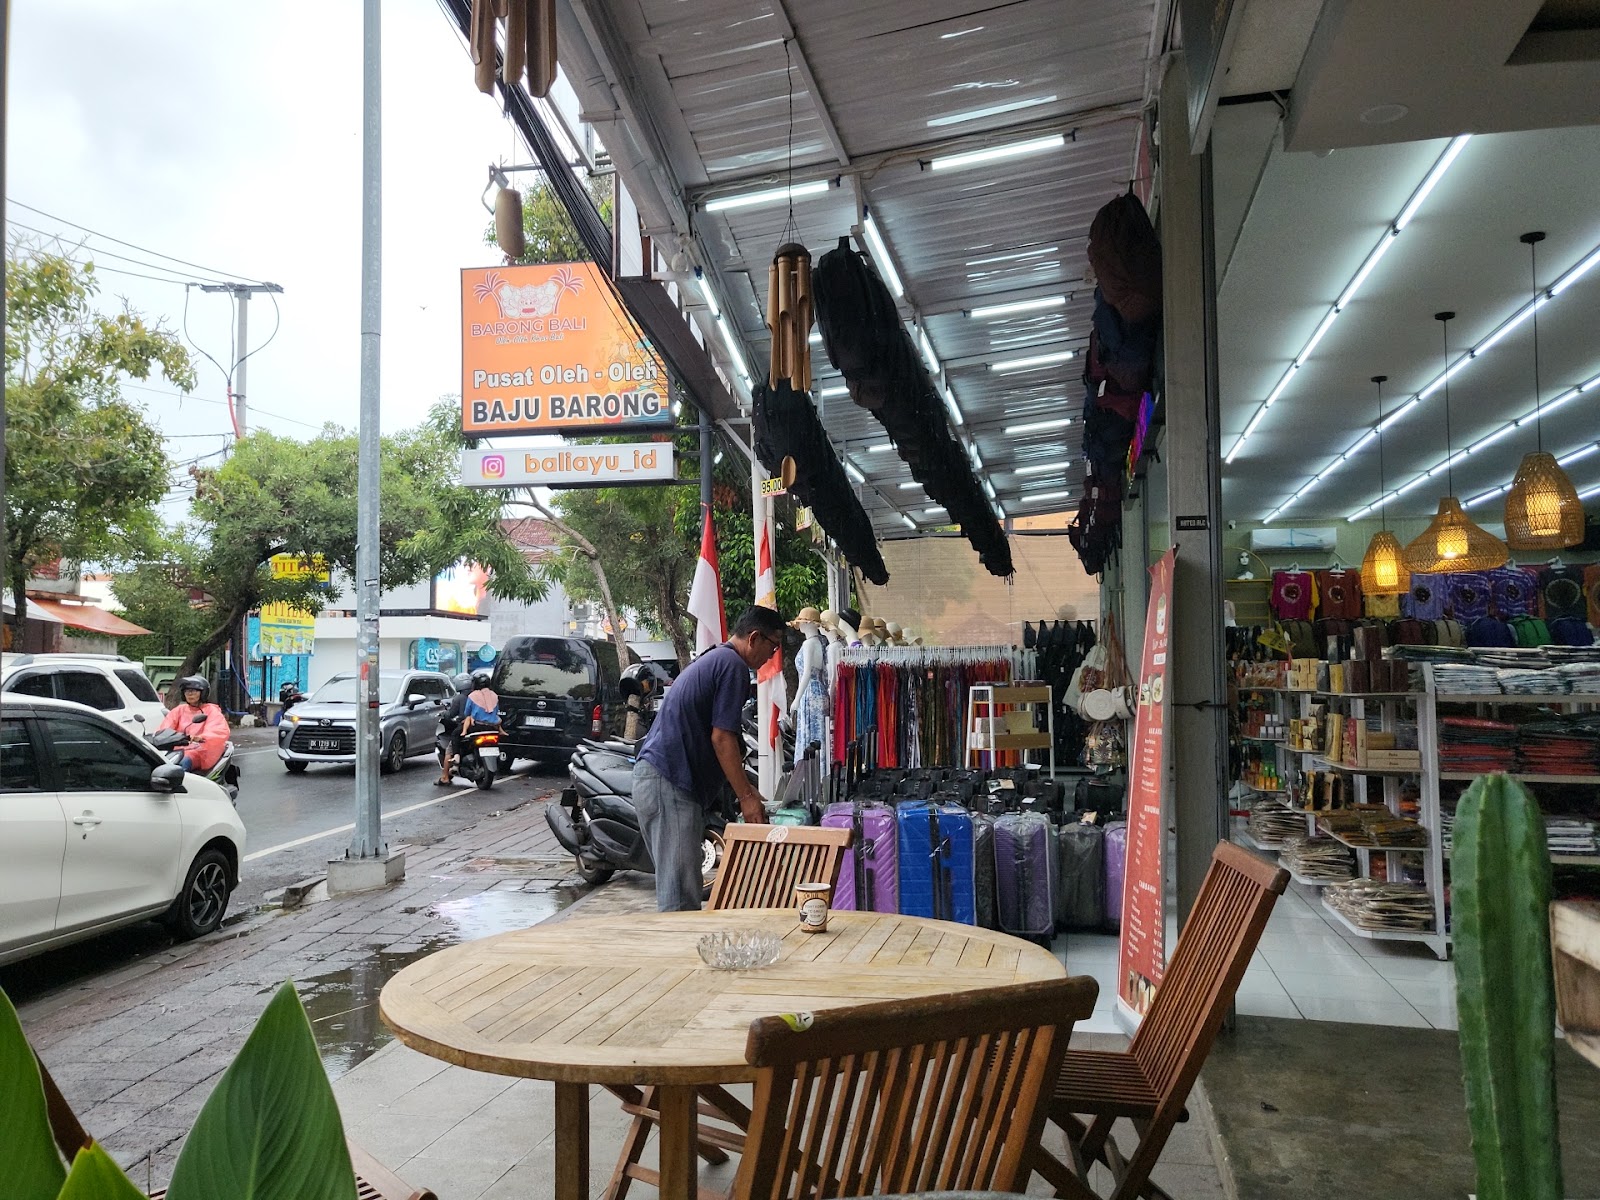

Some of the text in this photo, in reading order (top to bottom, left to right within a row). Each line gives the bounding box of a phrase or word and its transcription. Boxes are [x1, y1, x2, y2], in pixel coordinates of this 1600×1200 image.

[471, 317, 587, 337] BARONG BALI
[473, 366, 534, 389] Pusat
[540, 364, 589, 385] Oleh
[608, 360, 658, 382] Oleh
[472, 392, 660, 424] BAJU BARONG
[524, 449, 658, 476] baliayu_id
